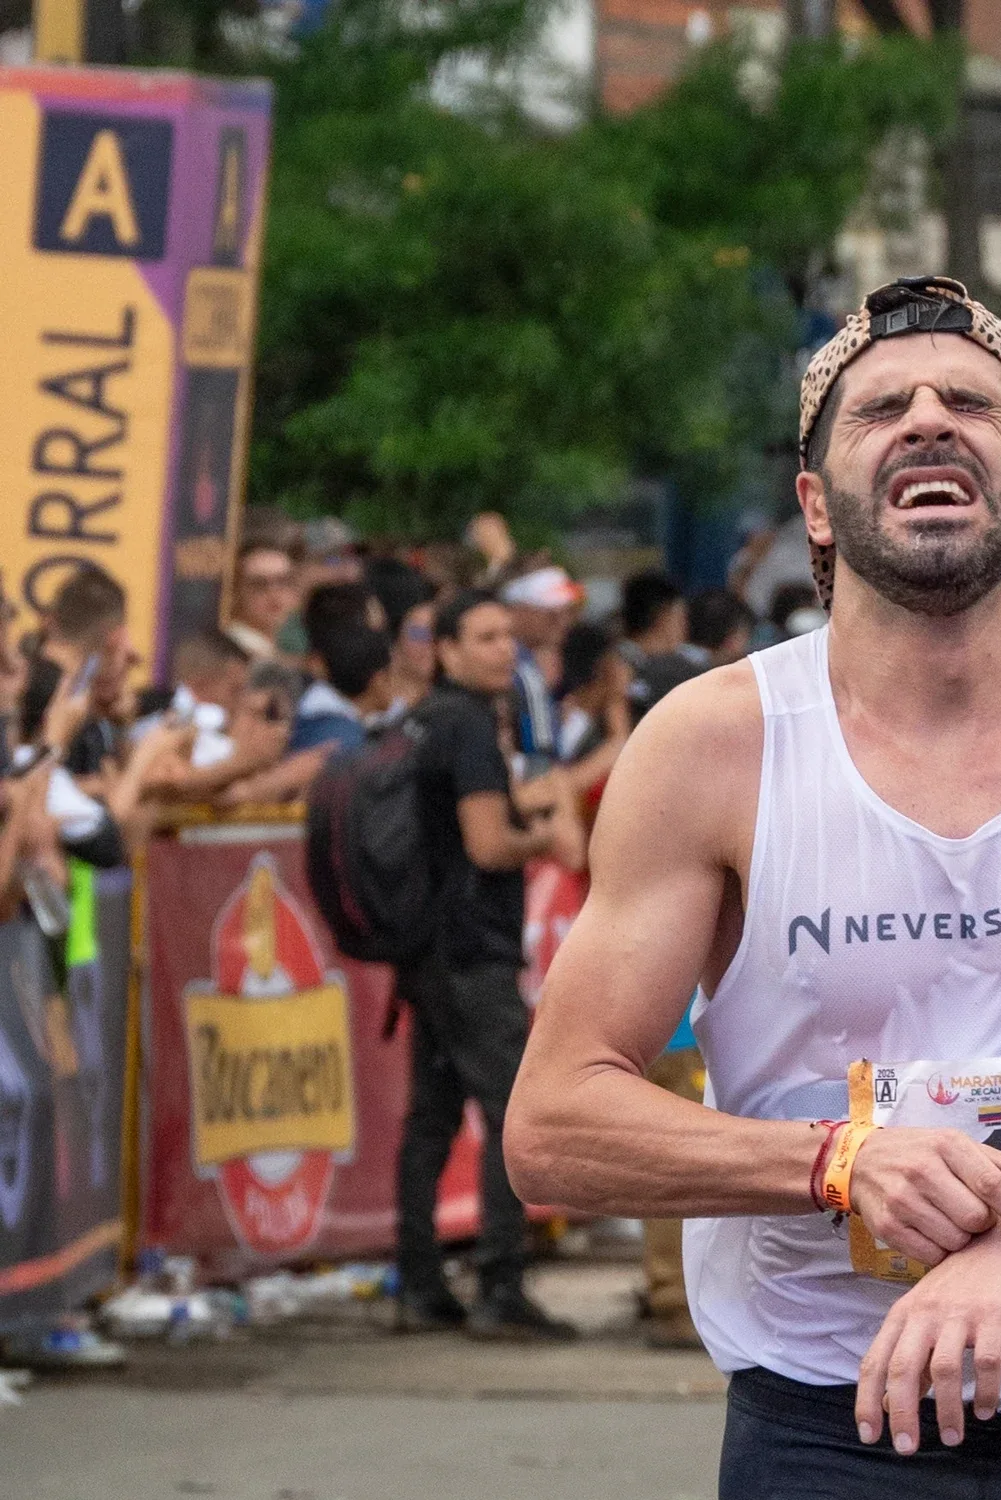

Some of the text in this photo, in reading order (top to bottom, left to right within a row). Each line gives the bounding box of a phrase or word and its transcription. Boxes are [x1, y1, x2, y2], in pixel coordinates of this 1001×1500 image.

[59, 129, 141, 246] A
[22, 304, 136, 622] ORRAL
[877, 1068, 896, 1078] 2025
[880, 1081, 892, 1101] A
[971, 1087, 1001, 1096] DE CALI
[826, 1183, 844, 1207] VIP
